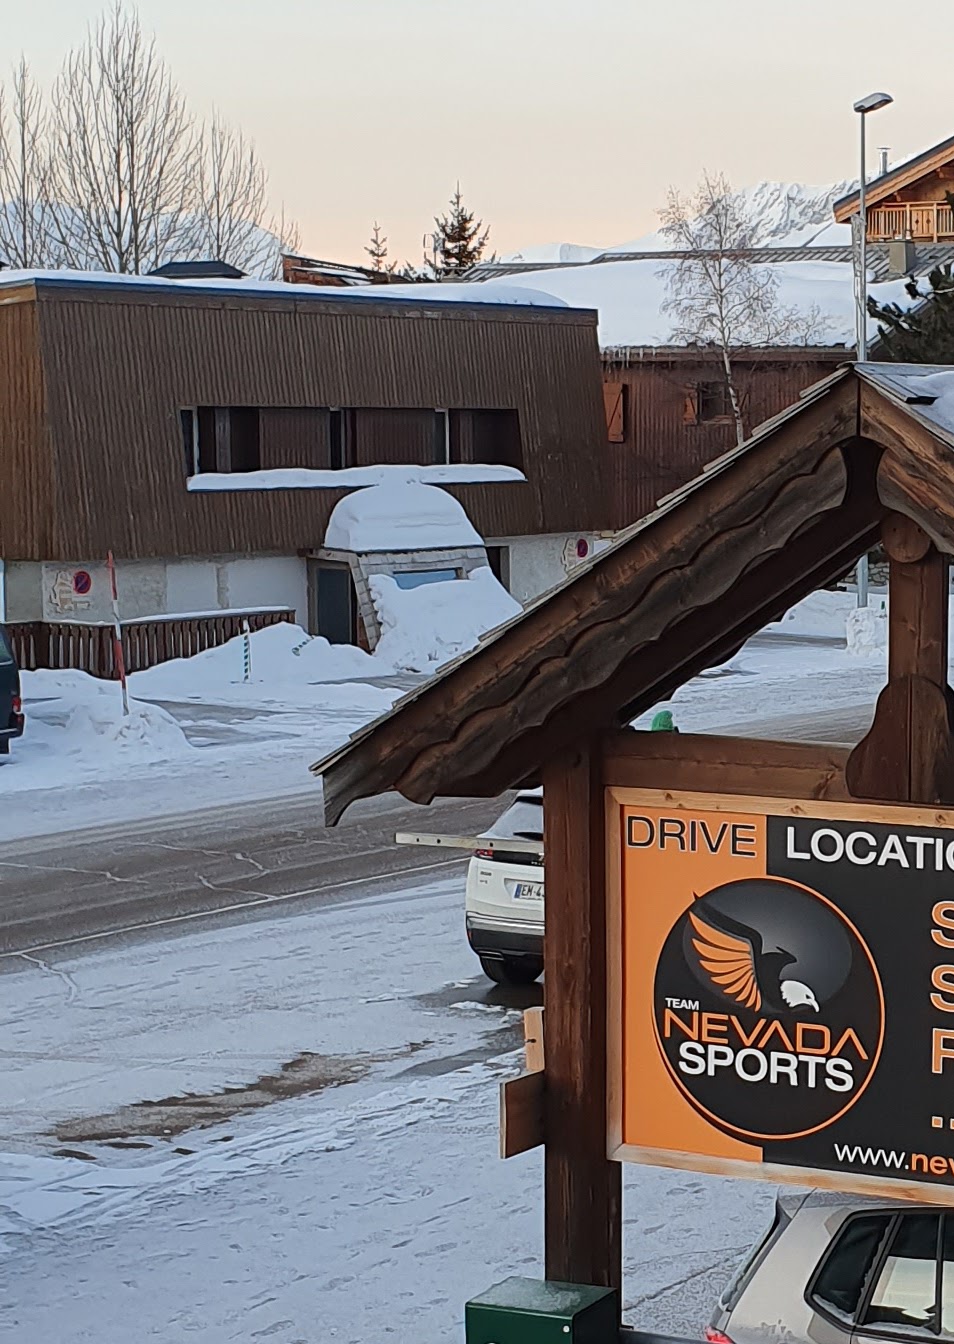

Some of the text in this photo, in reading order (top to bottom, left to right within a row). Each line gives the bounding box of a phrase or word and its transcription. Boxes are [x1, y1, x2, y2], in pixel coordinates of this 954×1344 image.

[626, 815, 757, 858] DRIVE
[664, 997, 700, 1011] TEAM
[663, 1008, 869, 1061] NEVADA
[678, 1041, 854, 1093] SPORTS
